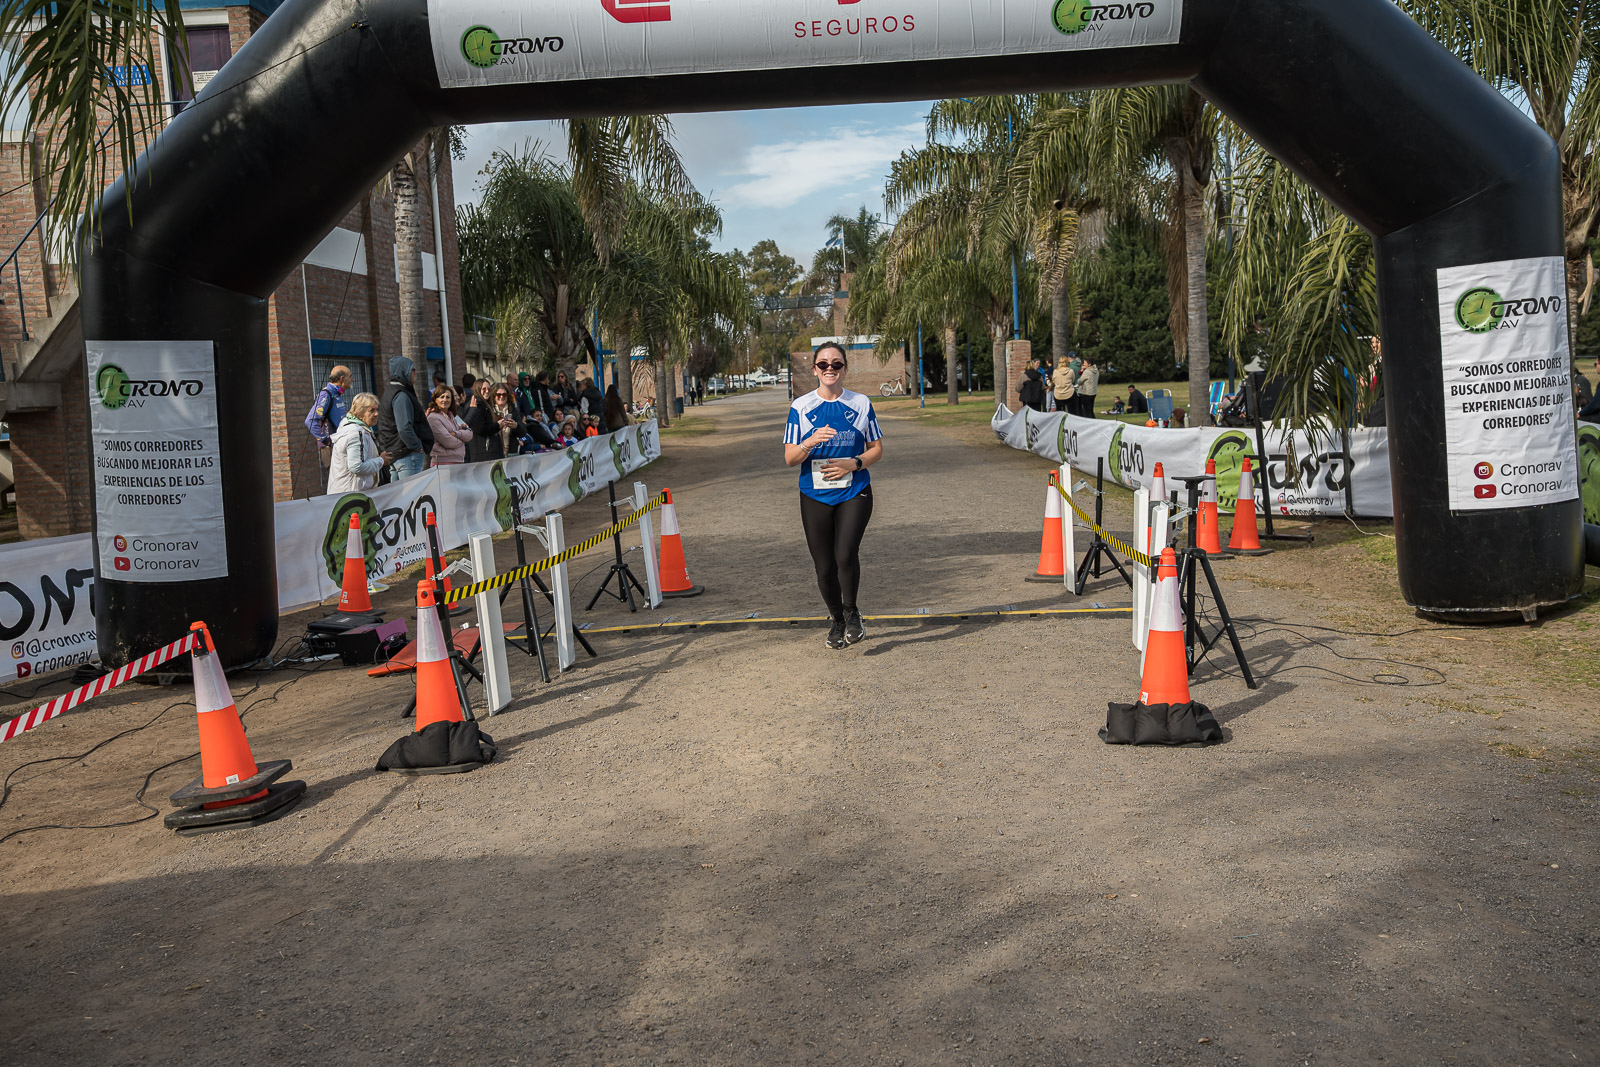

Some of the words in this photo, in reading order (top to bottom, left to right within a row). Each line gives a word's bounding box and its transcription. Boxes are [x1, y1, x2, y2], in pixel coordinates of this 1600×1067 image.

[1080, 2, 1155, 22] CRONO
[794, 15, 915, 38] SEGUROS
[1078, 23, 1104, 33] RAV
[490, 36, 564, 56] CRONO
[490, 57, 516, 66] RAV
[1490, 296, 1561, 318] CRONO
[1489, 319, 1519, 330] RAV
[1506, 357, 1562, 374] CORREDORES
[119, 380, 204, 397] CRONO
[1451, 381, 1511, 396] BUSCANDO
[1513, 376, 1557, 391] MEJORAR
[1557, 374, 1568, 386] LAS
[119, 400, 146, 408] RAV
[1462, 396, 1537, 413] EXPERIENCIAS
[1540, 395, 1551, 406] DE
[1552, 393, 1564, 405] LOS
[134, 440, 204, 452] CORREDORES
[97, 457, 139, 470] BUSCANDO
[141, 457, 191, 471] MEJORAR
[194, 456, 214, 468] LAS
[1500, 461, 1562, 476] Cronorav
[104, 474, 166, 488] EXPERIENCIAS
[169, 475, 183, 488] DE
[185, 474, 205, 487] LOS
[1501, 480, 1563, 495] Cronorav
[132, 539, 199, 552] Cronorav
[133, 558, 201, 571] Cronorav
[34, 649, 93, 675] cronorav
